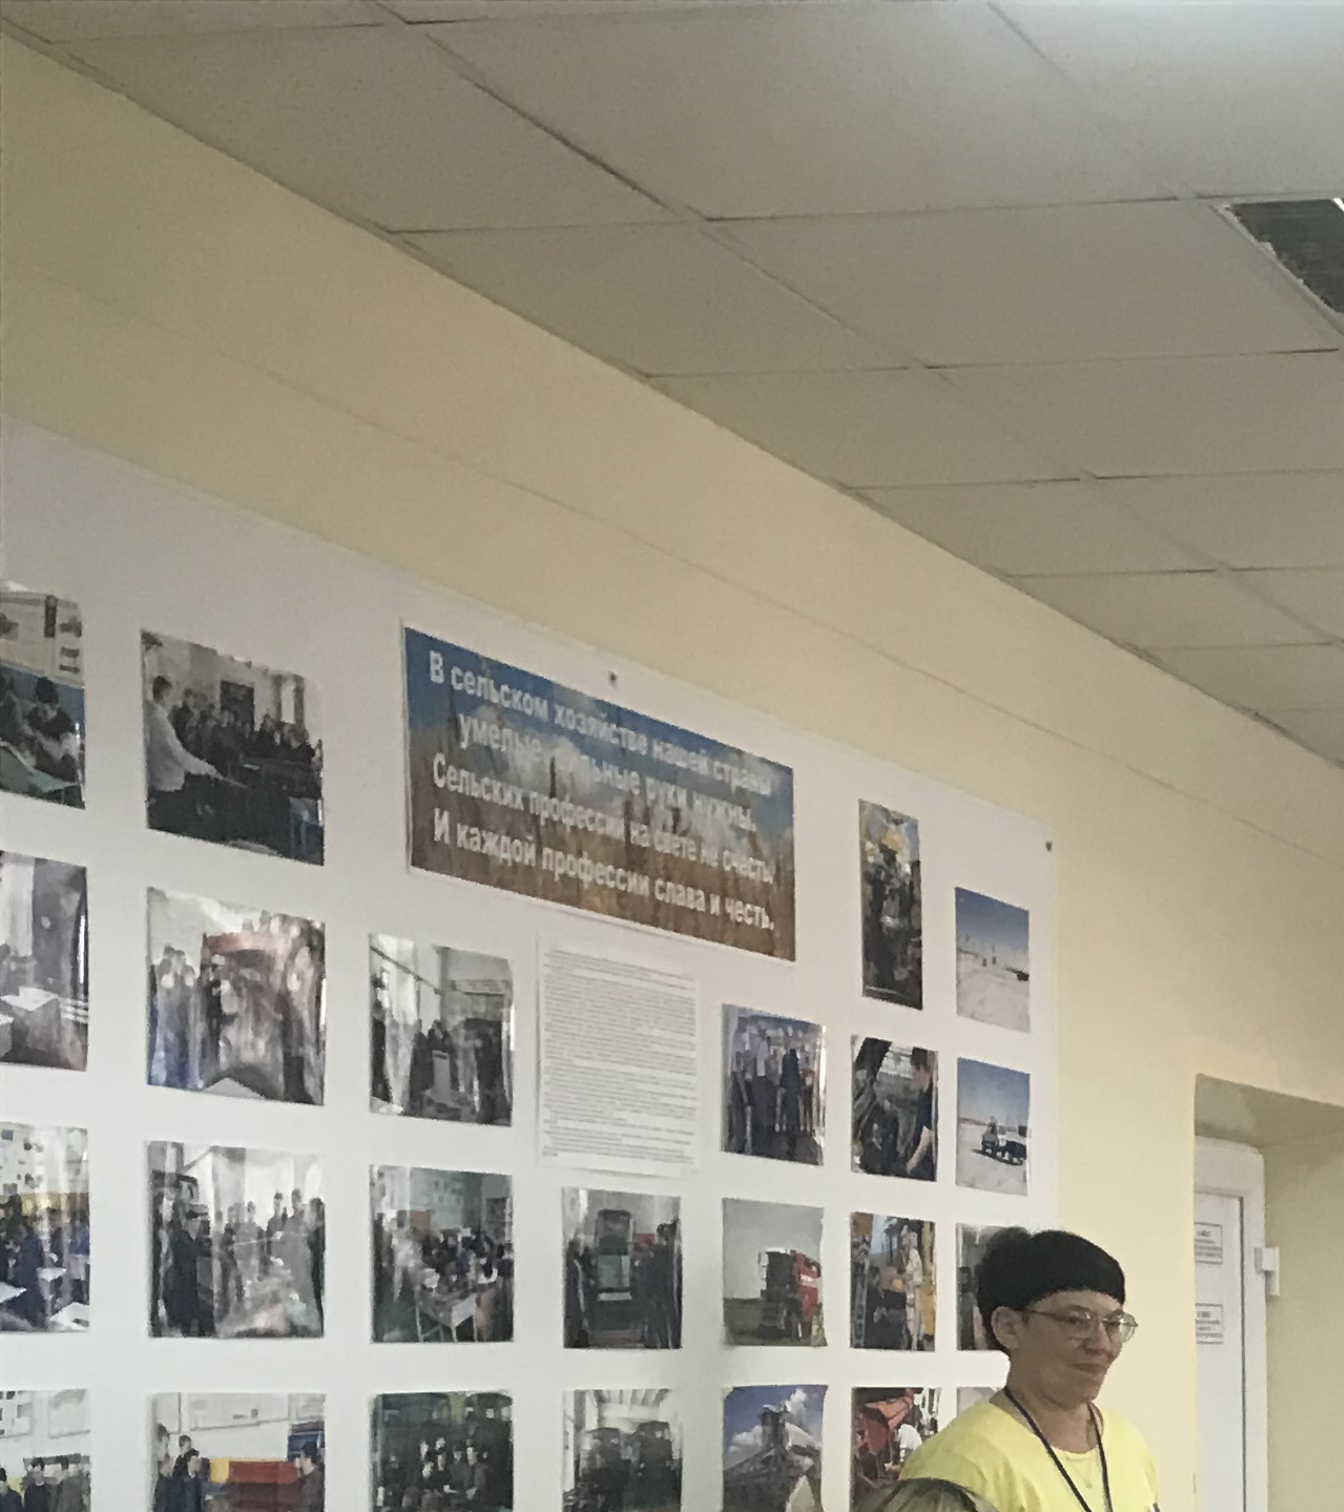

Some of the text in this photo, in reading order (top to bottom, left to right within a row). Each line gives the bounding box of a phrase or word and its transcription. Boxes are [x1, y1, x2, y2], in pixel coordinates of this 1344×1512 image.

[429, 650, 444, 684] В
[451, 666, 548, 720] сельском
[553, 703, 649, 755] хозяйстве
[459, 713, 542, 753] умелые
[433, 752, 524, 811] Сельских
[630, 821, 650, 848] на
[434, 808, 775, 931] И каждой профессии слава и честь.
